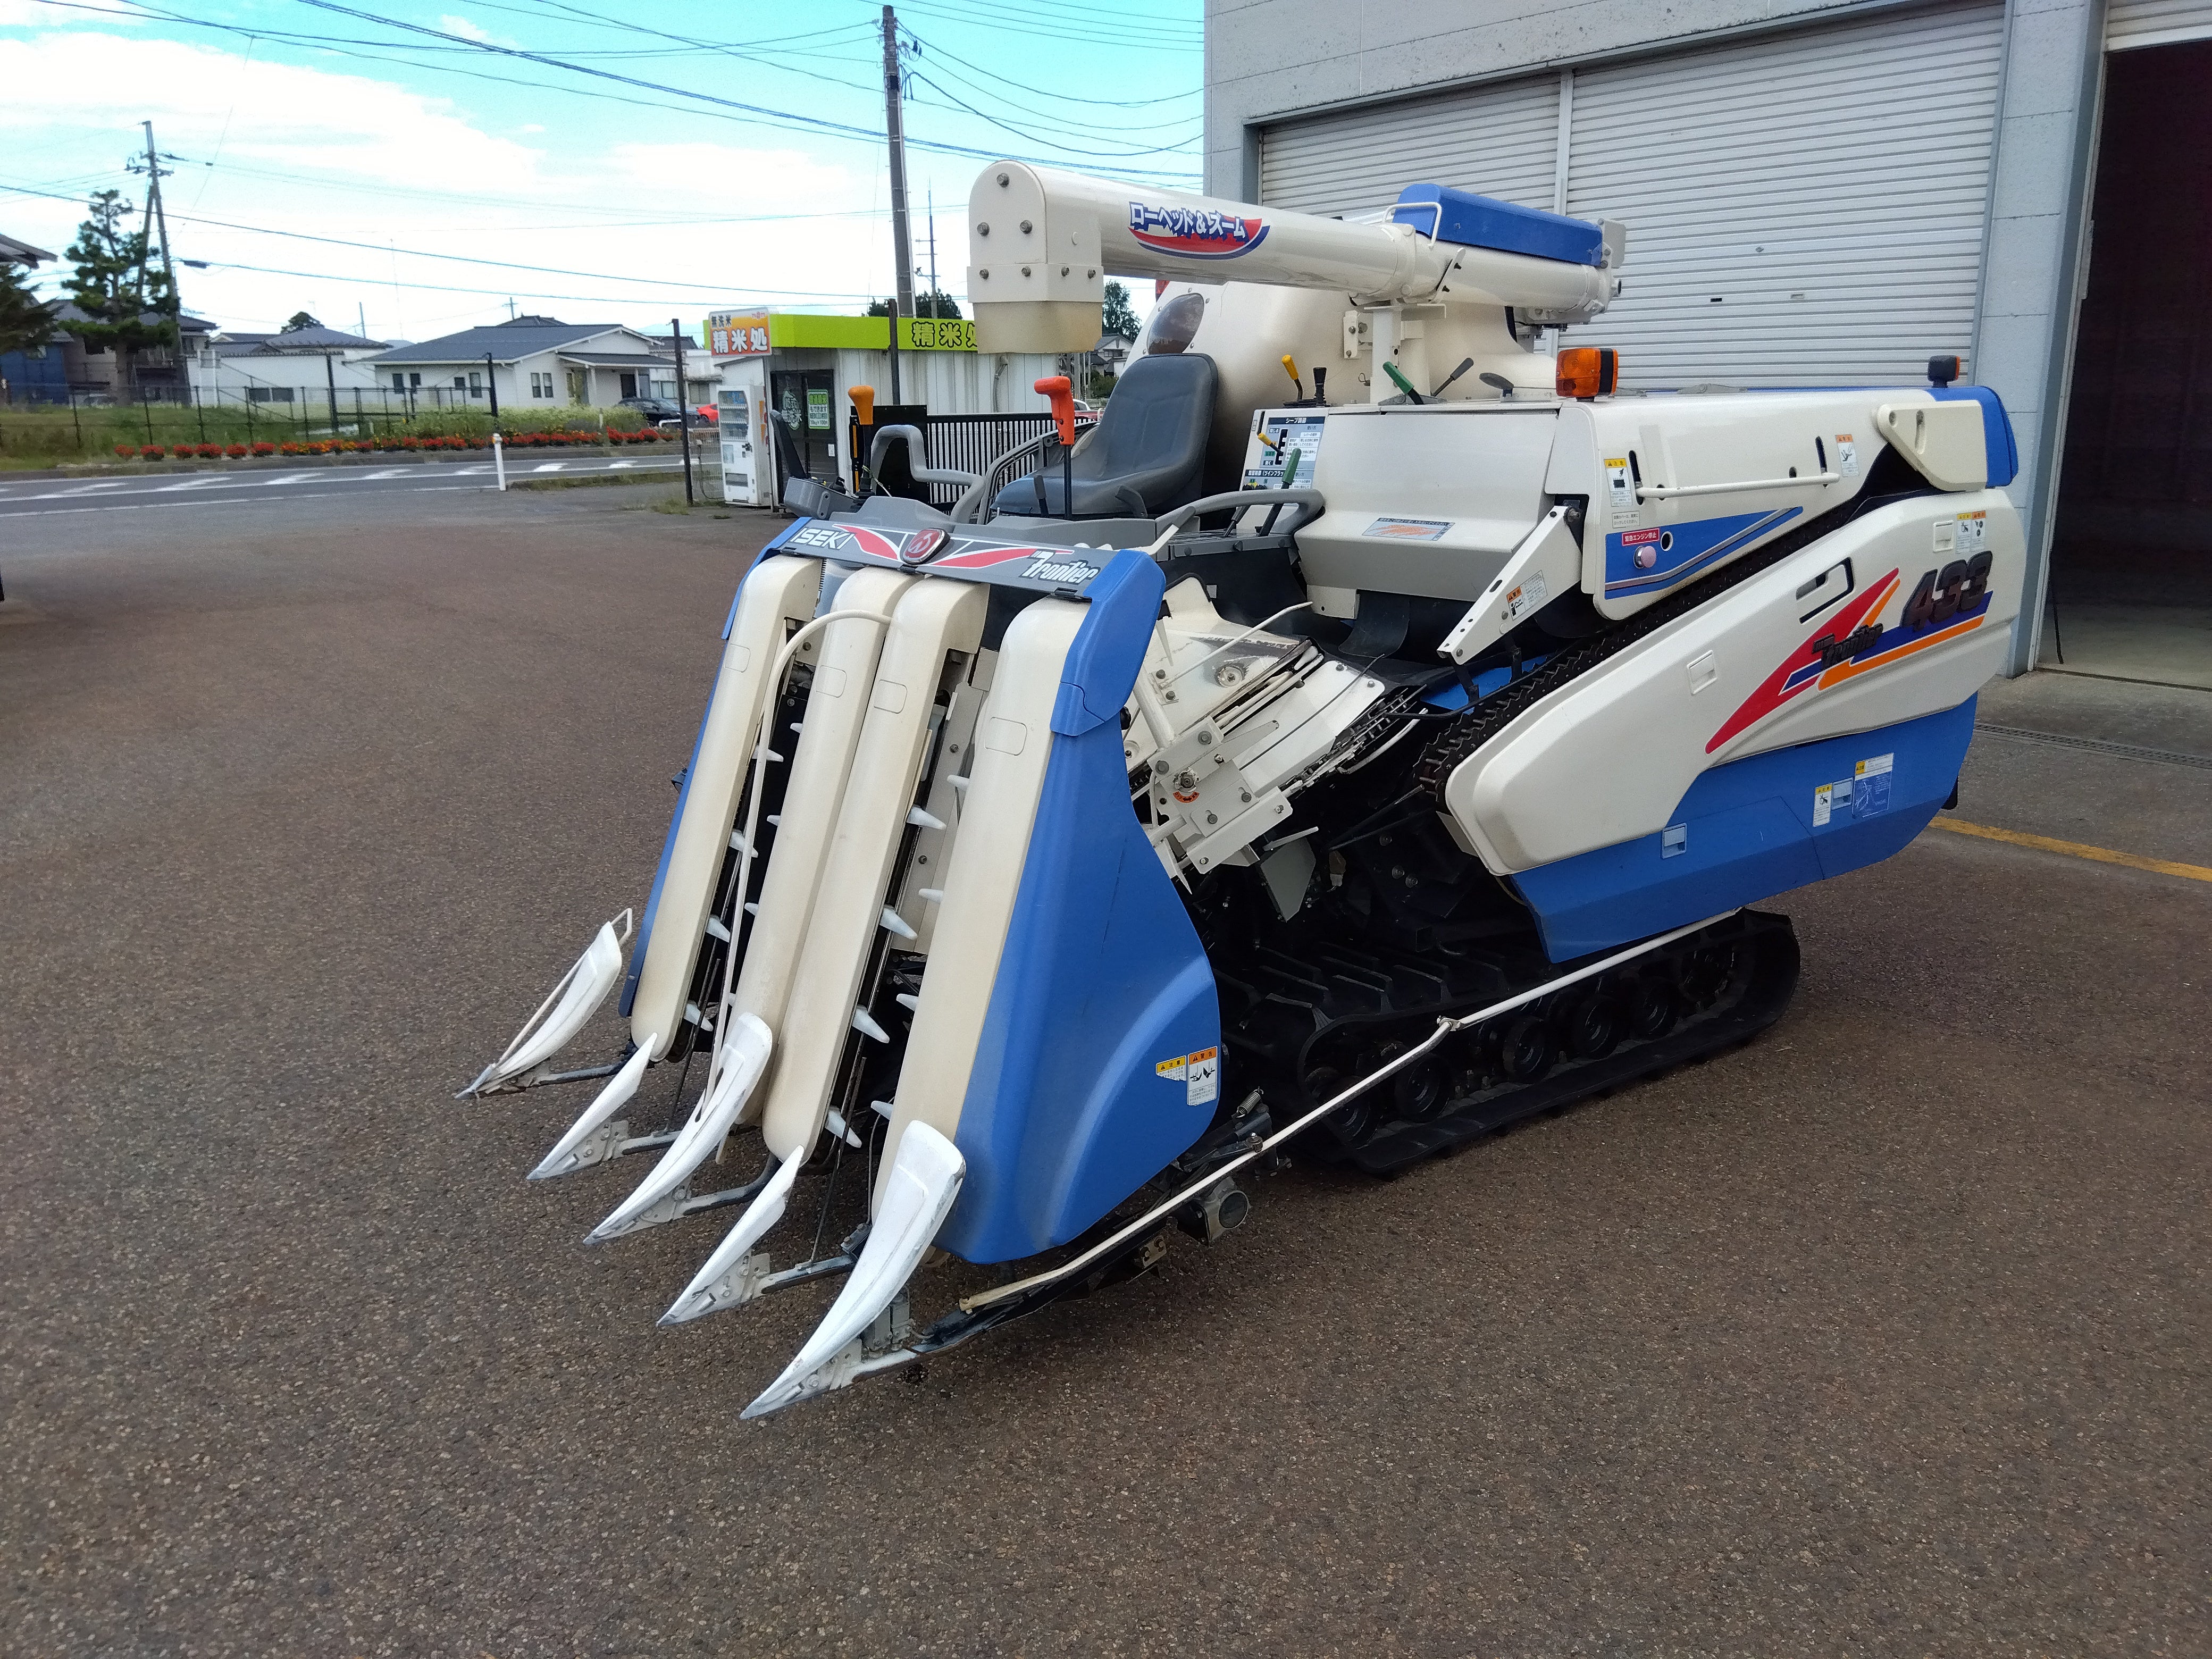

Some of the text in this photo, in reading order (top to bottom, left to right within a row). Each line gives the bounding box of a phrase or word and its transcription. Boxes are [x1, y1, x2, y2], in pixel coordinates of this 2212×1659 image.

[711, 314, 732, 328] 無洗米
[713, 327, 768, 354] 精米処
[789, 527, 856, 550] ISEKI
[1624, 532, 1656, 542] 緊急エンジン停止
[1020, 550, 1100, 584] Frontier
